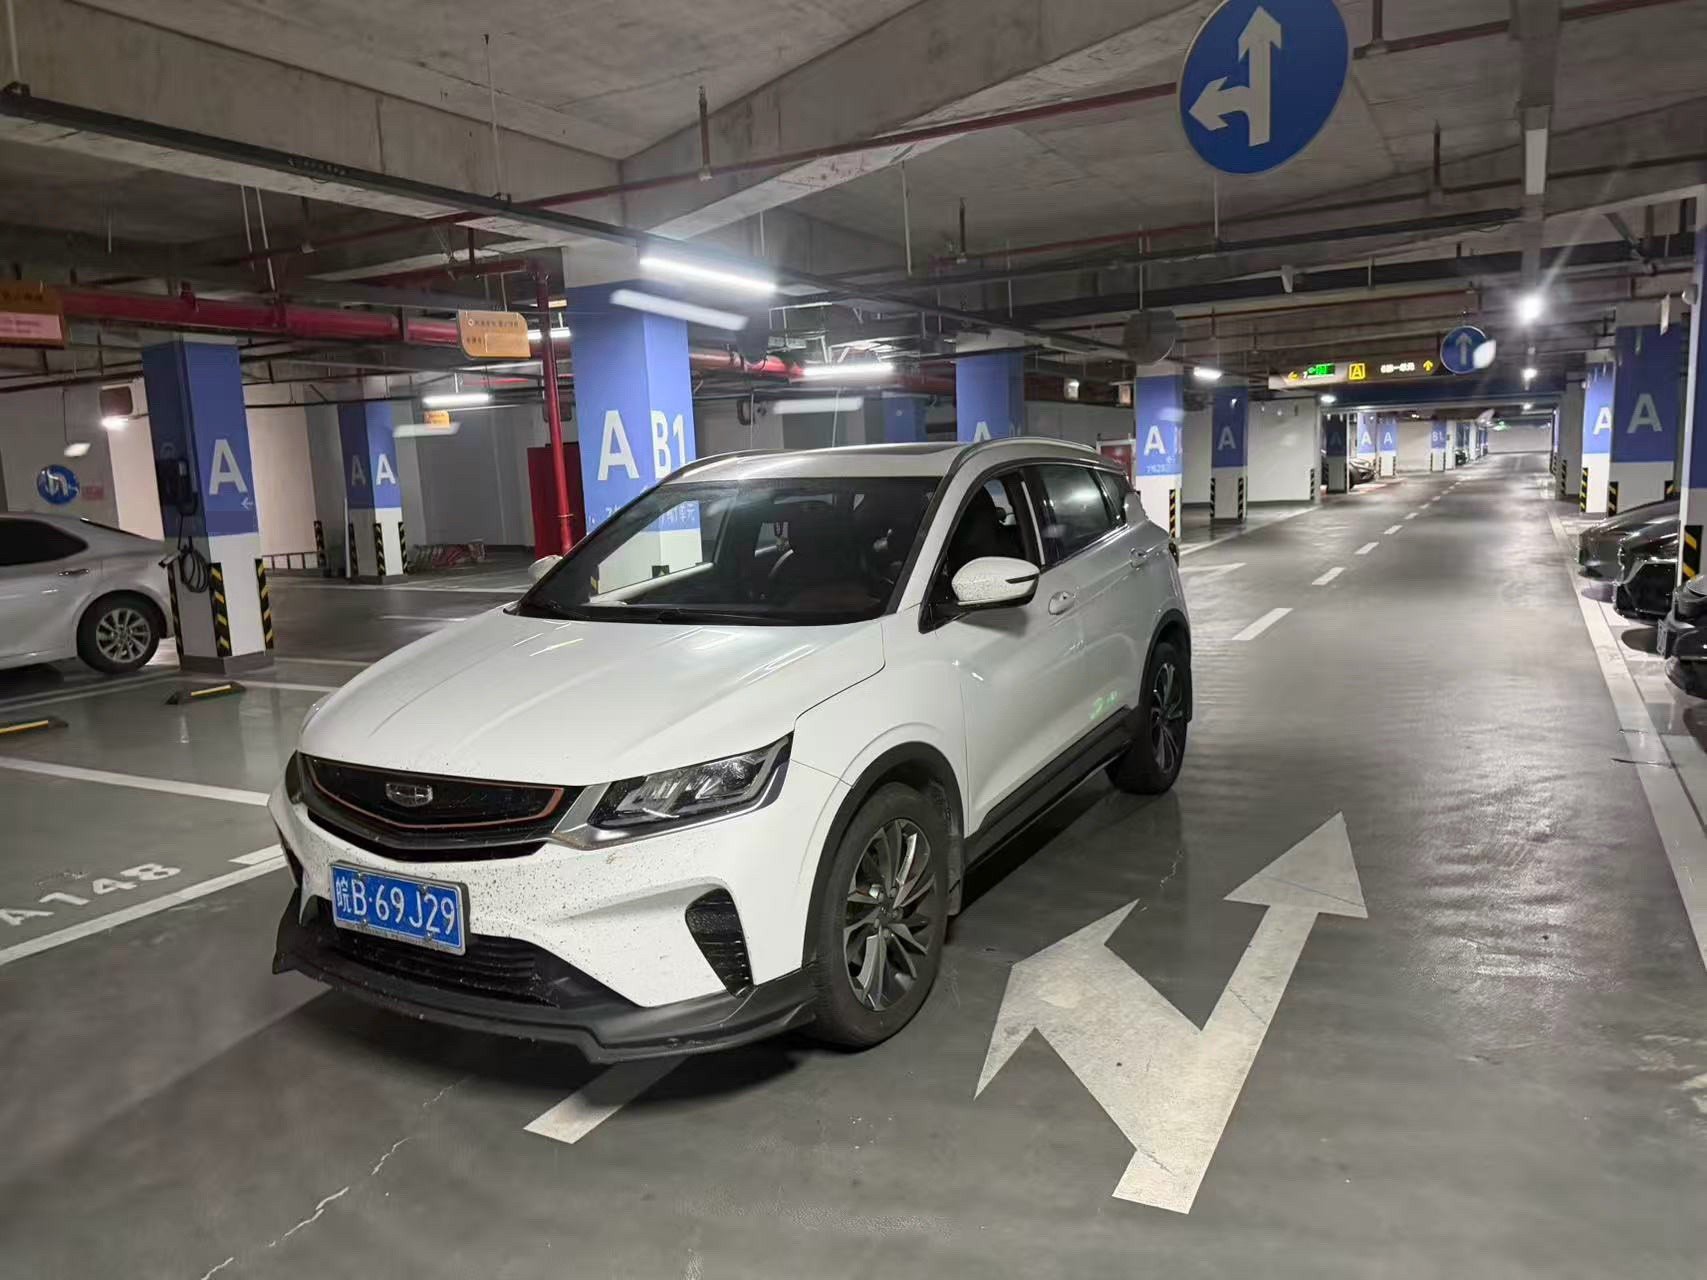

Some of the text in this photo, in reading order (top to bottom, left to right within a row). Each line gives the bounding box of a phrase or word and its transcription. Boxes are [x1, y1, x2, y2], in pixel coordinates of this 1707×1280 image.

[1349, 363, 1365, 379] A
[1593, 407, 1612, 435] A
[1625, 393, 1663, 434] A
[597, 410, 640, 481] A
[650, 410, 687, 479] B1
[1144, 425, 1166, 456] A
[1217, 426, 1237, 451] A
[1361, 431, 1372, 446] A
[1383, 431, 1393, 444] A
[208, 438, 248, 496] A
[352, 455, 367, 486] A
[376, 453, 396, 486] A
[0, 862, 182, 926] A148
